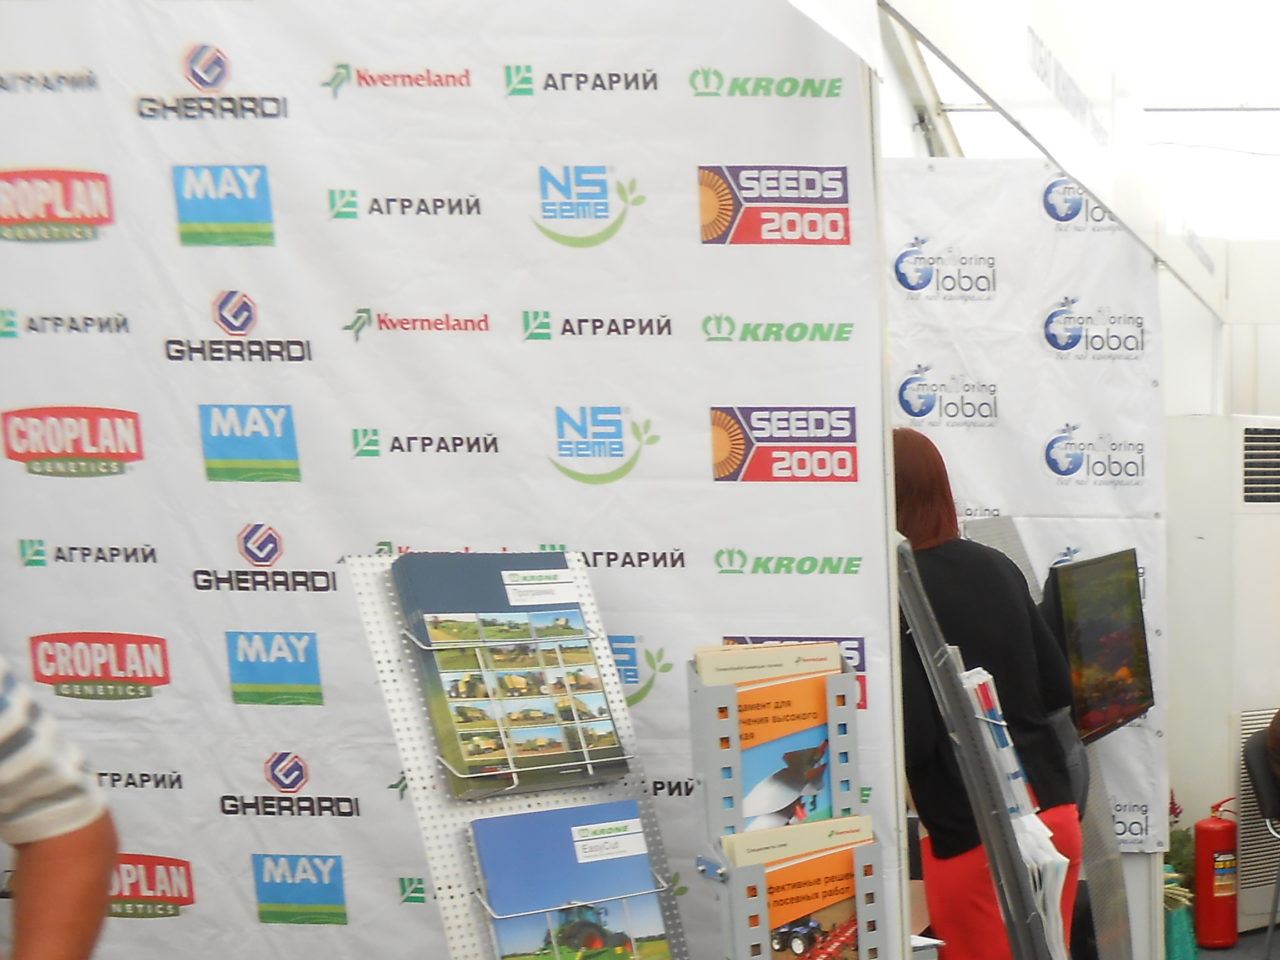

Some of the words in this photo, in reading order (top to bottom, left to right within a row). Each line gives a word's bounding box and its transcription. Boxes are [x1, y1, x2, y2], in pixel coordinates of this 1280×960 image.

[0, 70, 97, 93] АГРАРИЙ
[357, 69, 472, 88] Kverneland
[543, 69, 658, 91] АГРАРИЙ
[727, 77, 842, 98] KRONE
[138, 97, 288, 119] GHERARDI
[183, 168, 262, 200] MAY
[539, 165, 609, 200] NS
[739, 170, 843, 198] SEEDS
[0, 178, 108, 219] ROPLAN
[368, 195, 481, 215] АГРАРИЙ
[542, 201, 610, 219] seme
[760, 212, 846, 240] 2000
[914, 256, 995, 268] monoring
[26, 313, 130, 334] АГРАРИЙ
[377, 314, 490, 333] Kverneland
[560, 317, 672, 336] АГРАРИЙ
[1063, 313, 1143, 327] monoring
[739, 322, 854, 342] KRONE
[165, 340, 312, 361] GHERARDI
[916, 381, 997, 395] monoring
[8, 411, 138, 454] CROPLAN
[210, 408, 287, 437] MAY
[555, 407, 623, 439] NS
[750, 411, 851, 438] SEEDS
[390, 434, 499, 453] АГРАРИЙ
[557, 441, 624, 457] seme
[1064, 442, 1144, 454] monoring
[30, 461, 121, 474] GENETICS
[771, 451, 853, 477] 2000
[54, 544, 158, 563] АГРАРИЙ
[751, 557, 863, 575] KRONE
[193, 570, 337, 592] GHERARDI
[36, 639, 164, 678] CROPLAN
[236, 635, 312, 662] MAY
[57, 684, 148, 697] GENETICS
[98, 770, 183, 789] ГРАРИЙ
[220, 795, 360, 817] GHERARDI
[109, 864, 188, 897] OPLAN
[262, 857, 336, 885] MAY
[767, 877, 821, 895] фективные
[111, 903, 175, 915] NETICS
